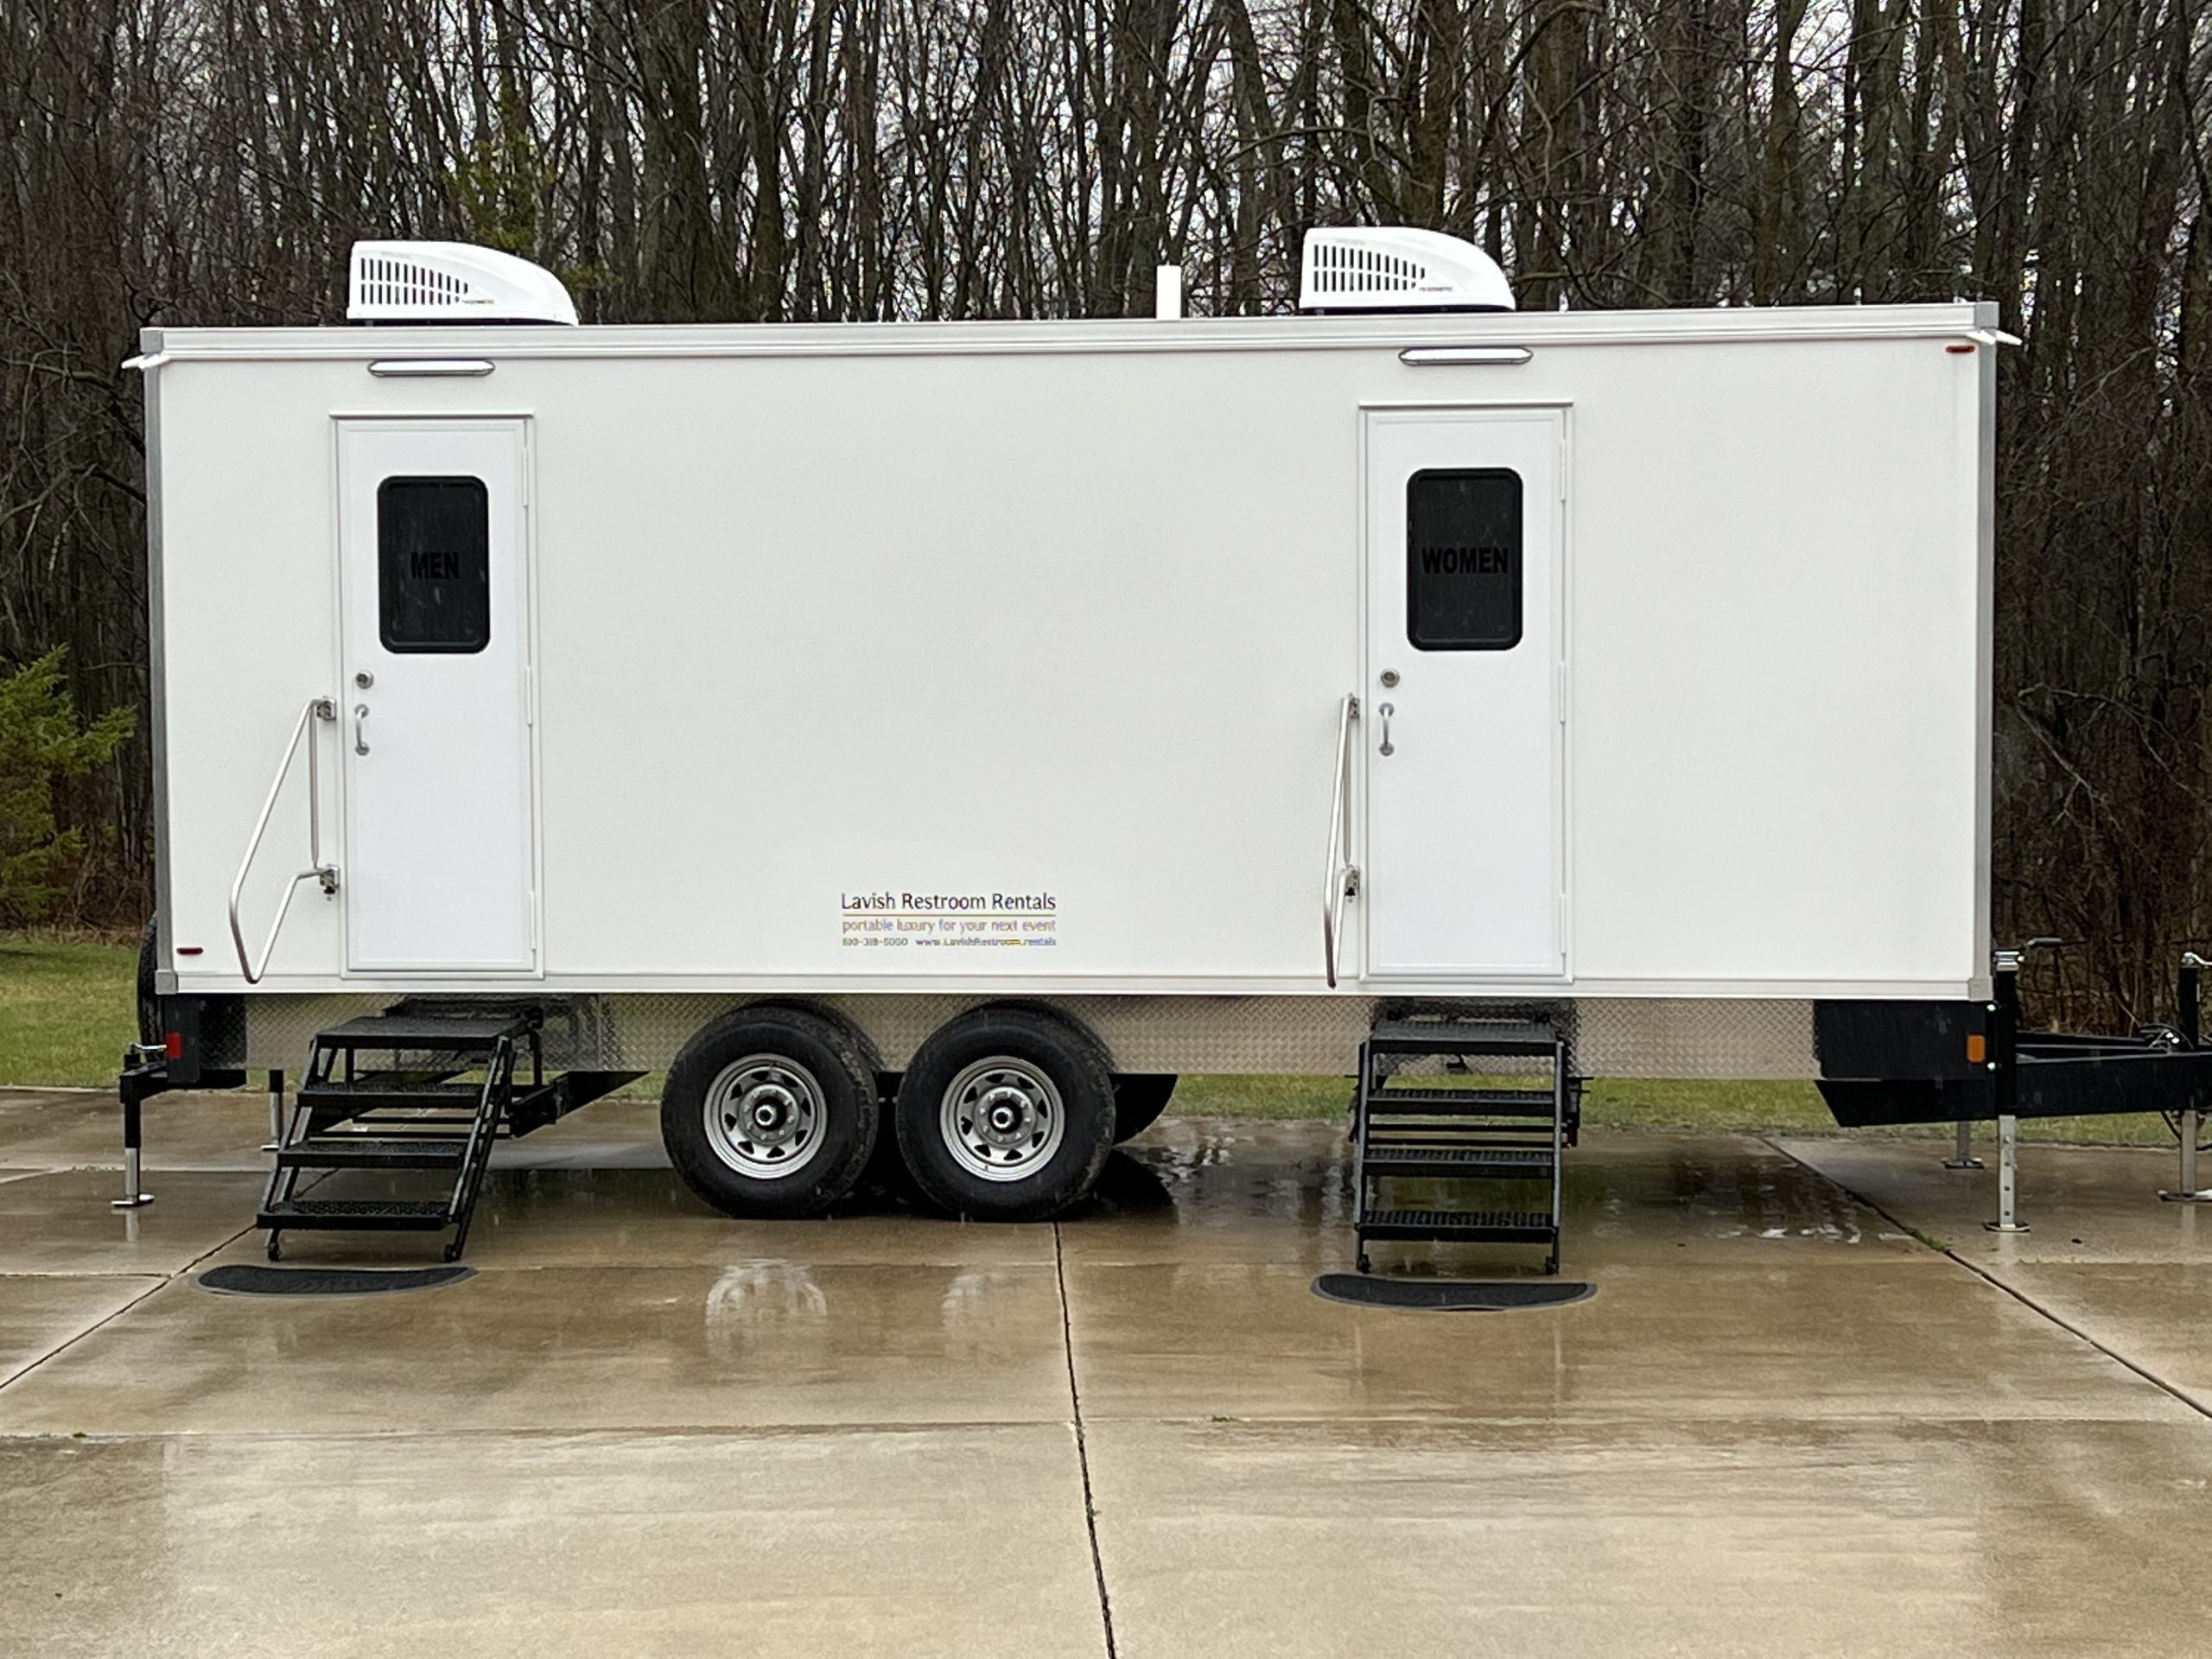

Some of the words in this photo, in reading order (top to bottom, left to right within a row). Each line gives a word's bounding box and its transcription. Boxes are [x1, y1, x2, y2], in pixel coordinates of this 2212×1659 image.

[410, 551, 460, 579] MEN
[1421, 547, 1509, 575] WOMEN
[842, 891, 896, 910] Lavish
[901, 893, 987, 910] Restroom
[992, 892, 1057, 910] Rentals
[842, 918, 894, 934] portable
[897, 918, 935, 935] luxury
[938, 918, 956, 931] for
[959, 921, 987, 935] your
[991, 920, 1018, 931] next
[1022, 920, 1056, 931] event
